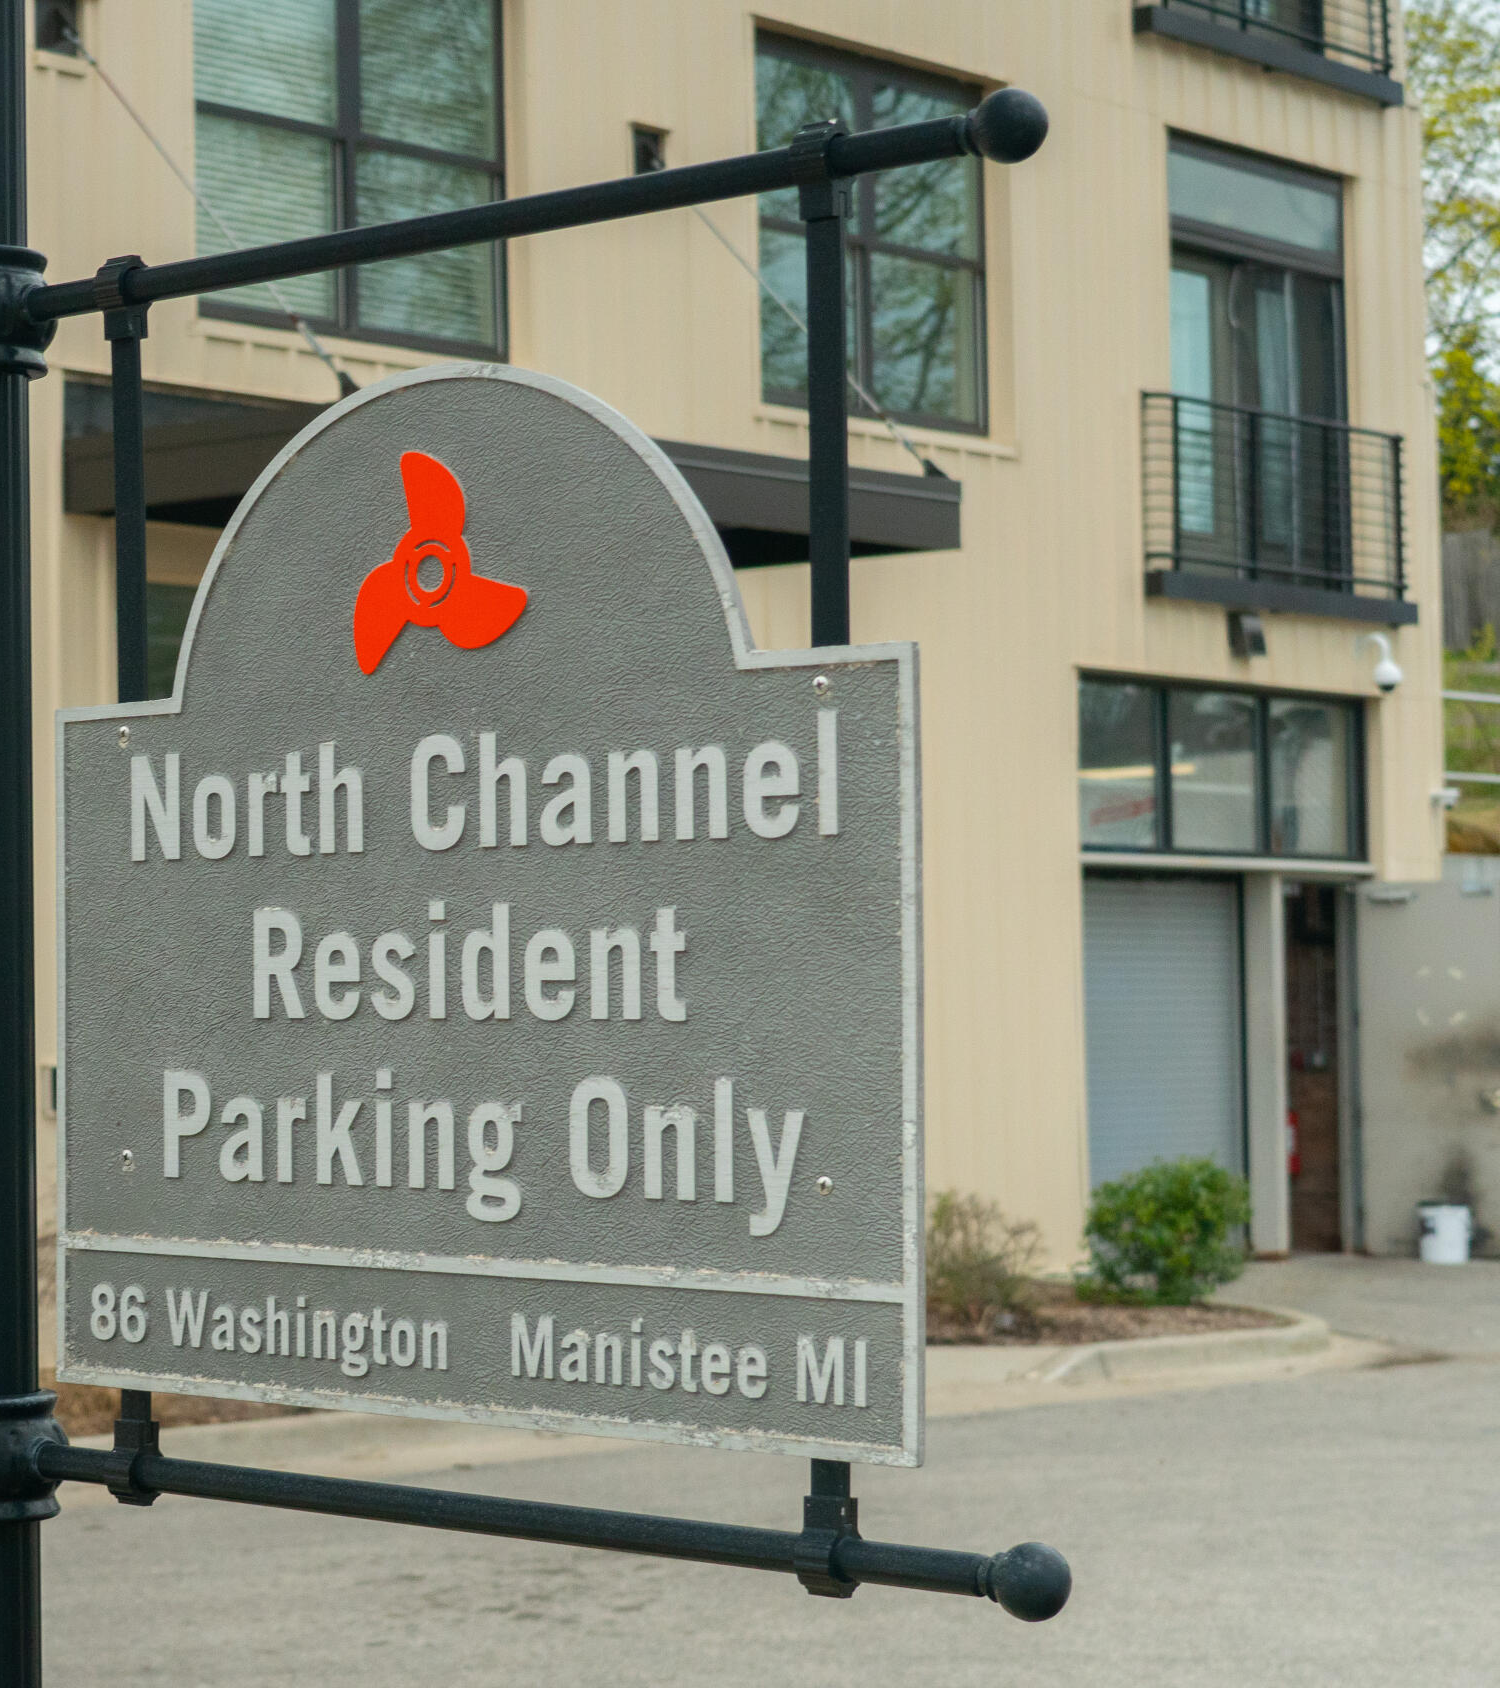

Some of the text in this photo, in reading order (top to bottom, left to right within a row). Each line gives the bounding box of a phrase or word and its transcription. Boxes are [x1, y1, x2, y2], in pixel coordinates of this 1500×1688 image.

[130, 709, 839, 862] North Channel
[253, 901, 687, 1022] Resident
[163, 1069, 806, 1237] Parking Only
[90, 1282, 868, 1408] 86 Washington Manistee MI
